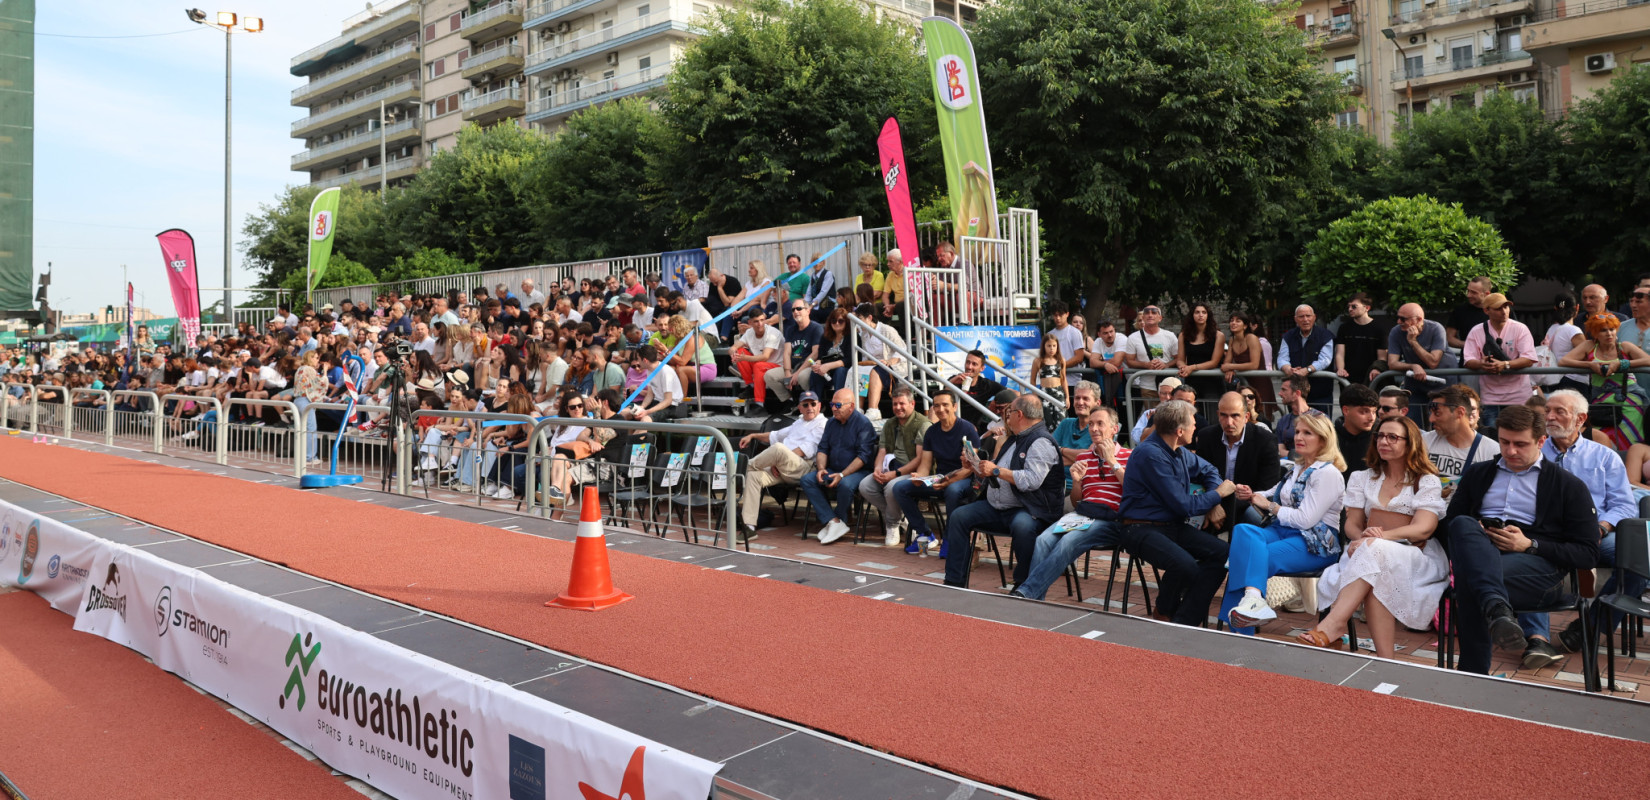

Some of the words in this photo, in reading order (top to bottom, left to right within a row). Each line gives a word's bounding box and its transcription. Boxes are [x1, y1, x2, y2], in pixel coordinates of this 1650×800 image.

[316, 213, 326, 236] Dole
[978, 330, 1001, 338] ΚΕΝΤΡΟ
[1003, 330, 1036, 338] ΠΡΟΜΗΘΕΑΣ
[85, 585, 127, 623] CROSSOVER
[317, 669, 474, 777] euroathletic
[317, 719, 342, 741] SPORTS
[348, 735, 354, 746] &
[359, 740, 417, 775] PLAYGROUND
[423, 768, 473, 800] EQUIPMENT
